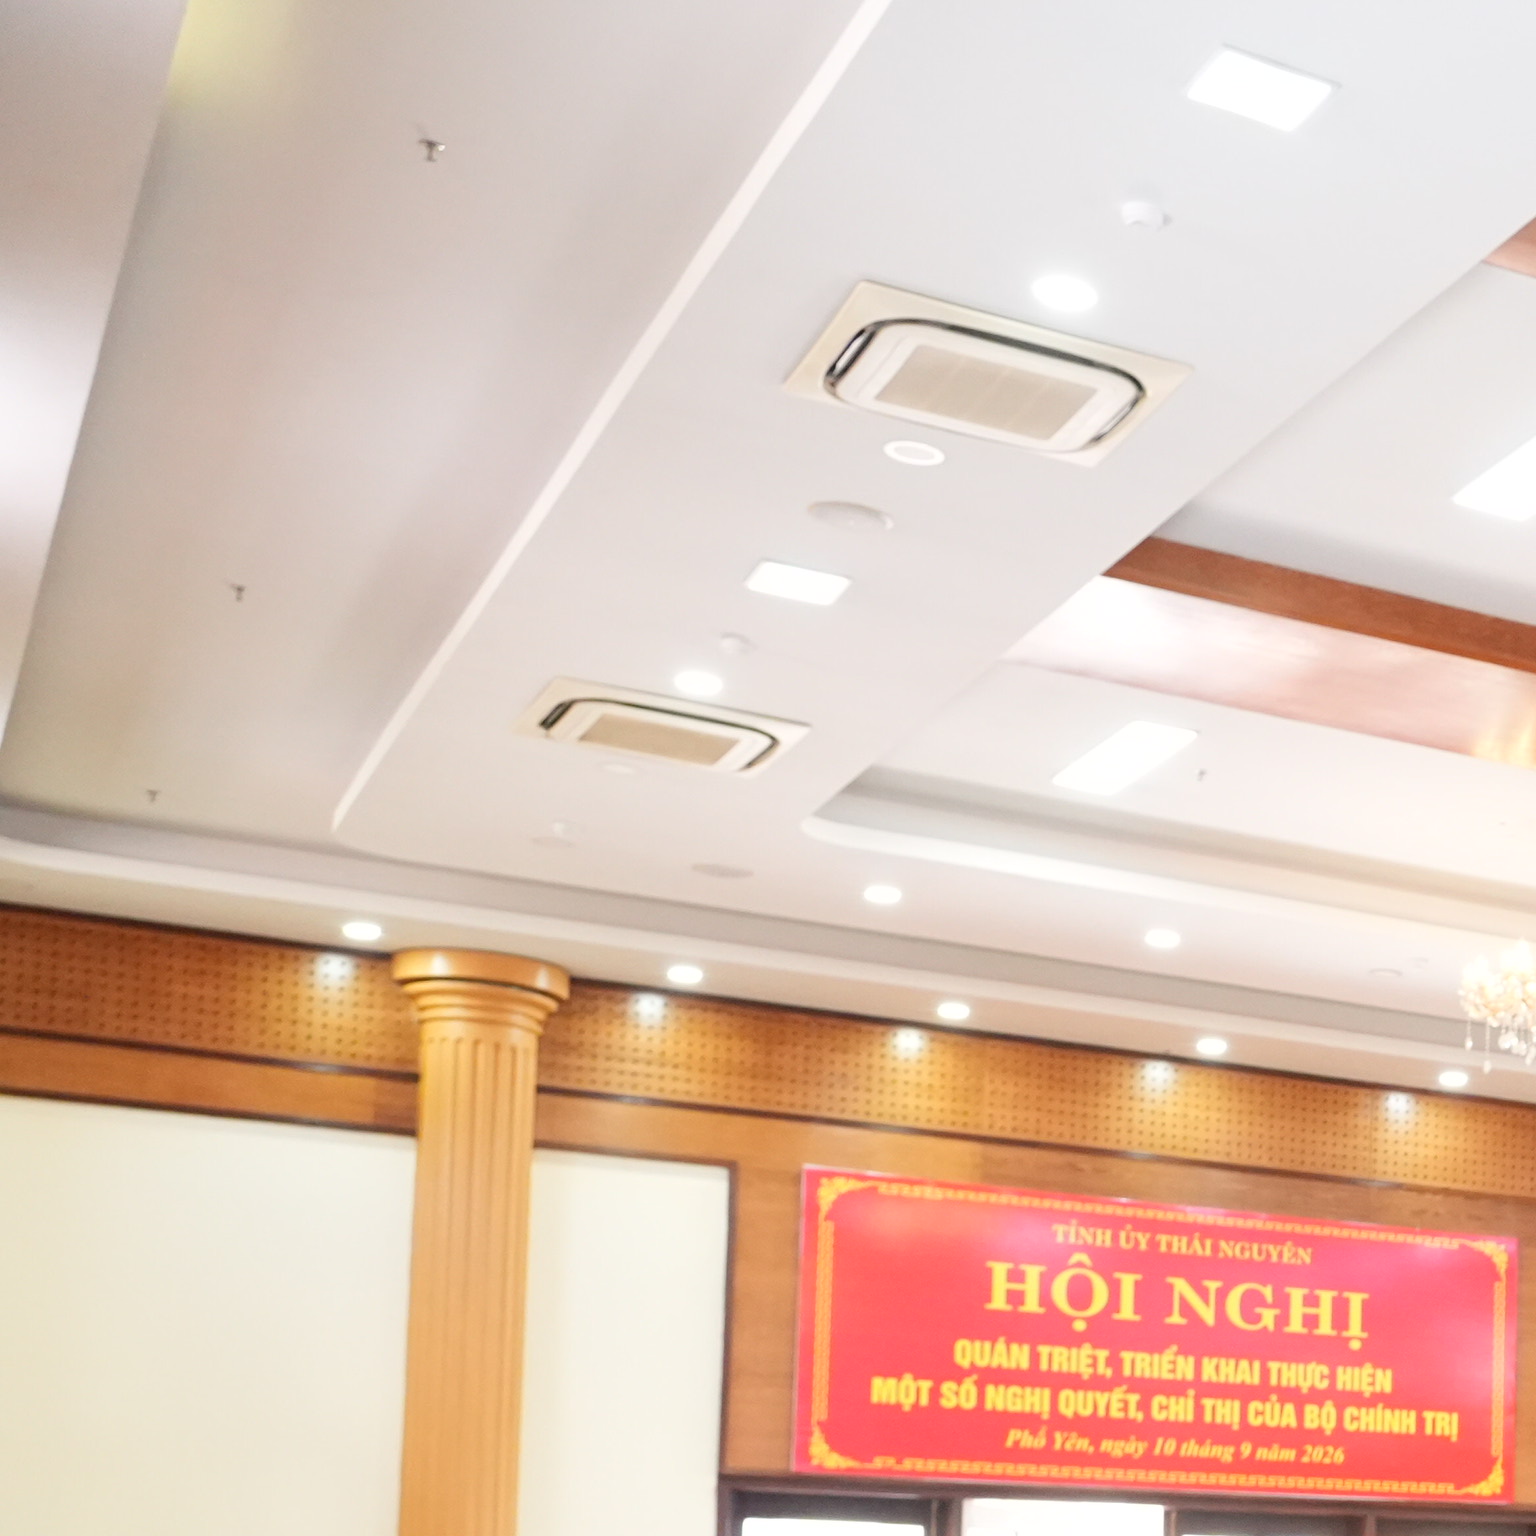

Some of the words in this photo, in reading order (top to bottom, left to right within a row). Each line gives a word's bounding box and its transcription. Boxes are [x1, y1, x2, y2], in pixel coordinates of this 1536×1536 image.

[1052, 1220, 1111, 1248] TỈNH
[1119, 1224, 1152, 1252] ỦY
[1156, 1230, 1213, 1257] THÁI
[1218, 1240, 1313, 1266] NGUYÊN
[984, 1252, 1142, 1332] HỘI
[1164, 1275, 1370, 1351] NGHỊ
[954, 1336, 1030, 1371] QUÁN
[1037, 1343, 1113, 1380] TRIỆT,
[1120, 1344, 1195, 1381] TRIỂN
[1201, 1356, 1261, 1386] KHAI
[1267, 1361, 1330, 1394] THỰC
[1336, 1362, 1393, 1398] HIỆN
[871, 1373, 933, 1412] MỘT
[939, 1374, 978, 1410] SỐ
[984, 1384, 1051, 1420] NGHỊ
[1058, 1385, 1144, 1423] QUYẾT,
[1151, 1389, 1195, 1423] CHỈ
[1201, 1397, 1241, 1431] THỊ
[1248, 1394, 1297, 1429] CỦA
[1304, 1400, 1338, 1436] BỘ
[1343, 1403, 1417, 1435] CHÍNH
[1422, 1410, 1459, 1442] TRỊ
[1005, 1426, 1048, 1450] Phố
[1053, 1430, 1096, 1454] Yên,
[1099, 1436, 1149, 1459] ngày
[1153, 1437, 1178, 1456] 10
[1179, 1439, 1235, 1464] tháng
[1240, 1441, 1253, 1460] 9
[1255, 1443, 1297, 1463] năm
[1301, 1445, 1346, 1465] 2026
